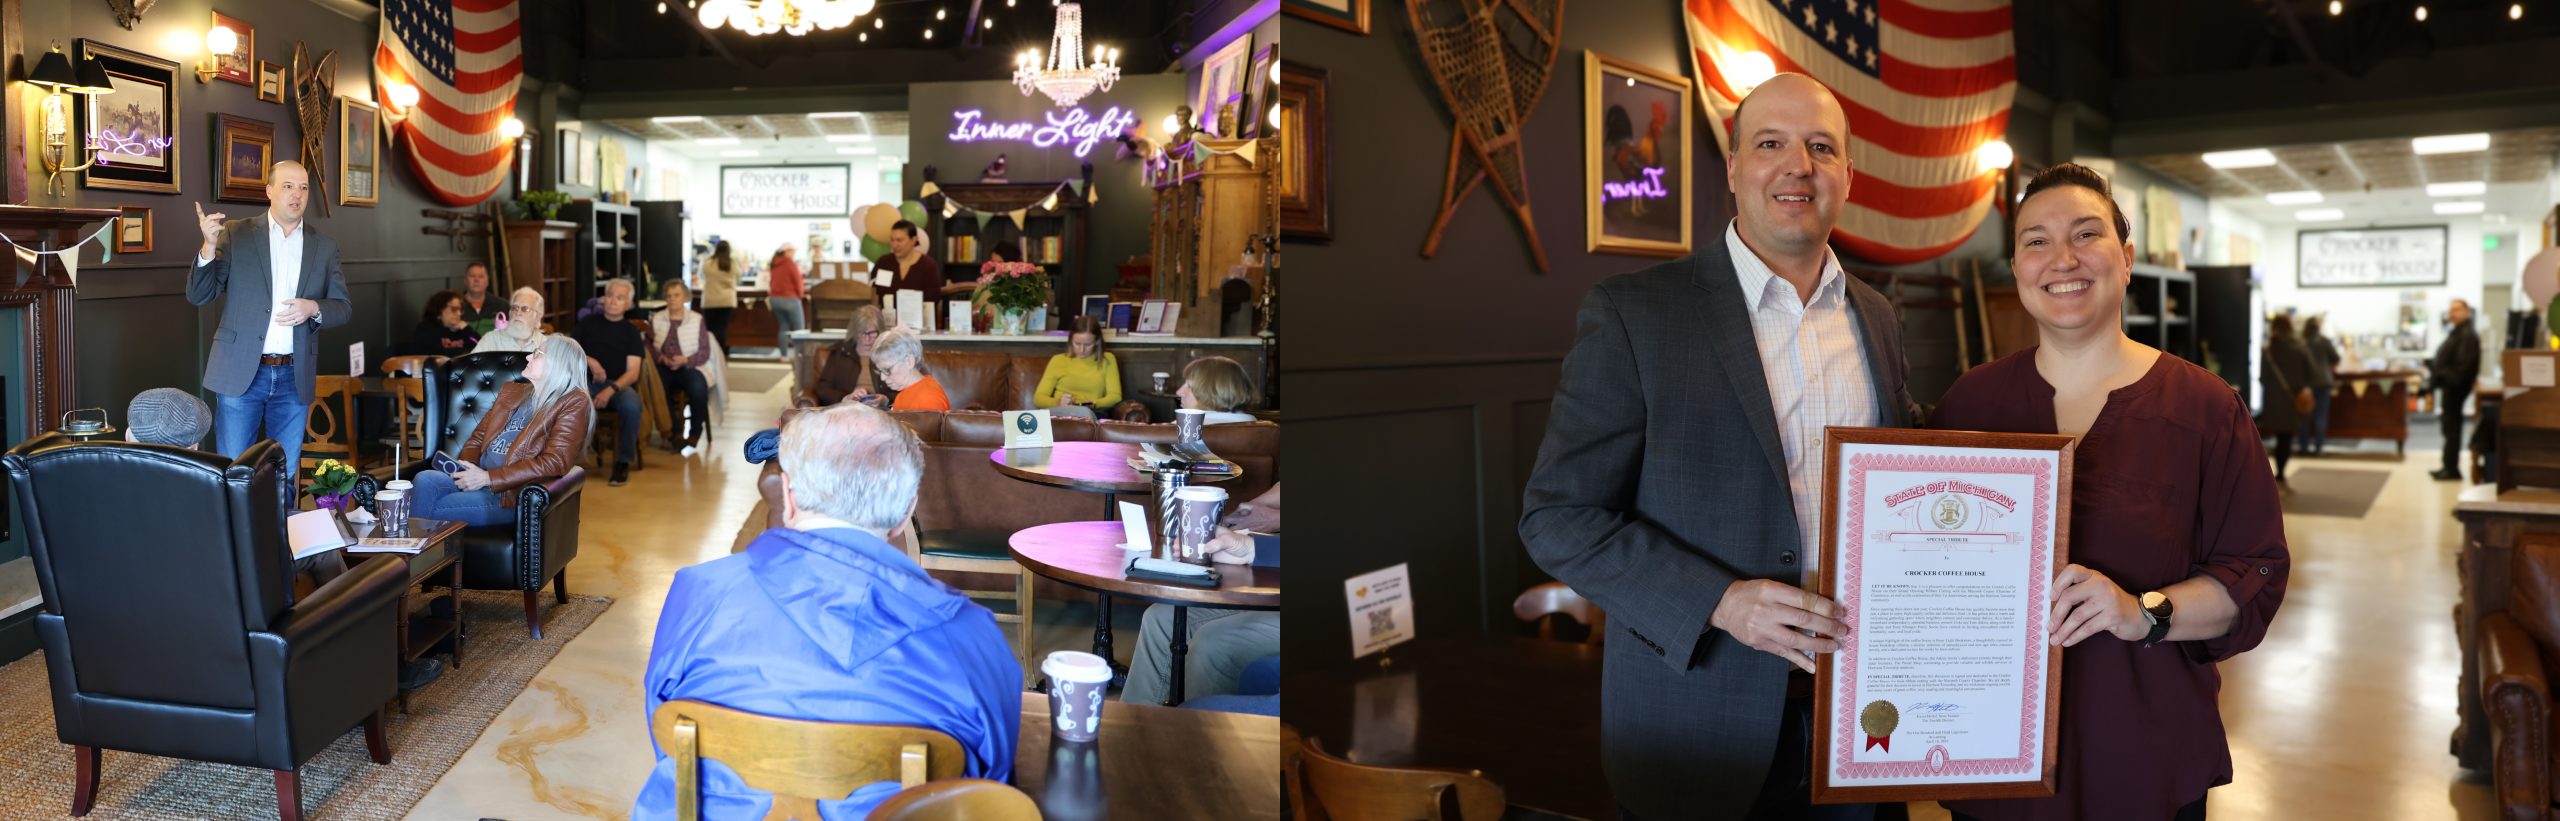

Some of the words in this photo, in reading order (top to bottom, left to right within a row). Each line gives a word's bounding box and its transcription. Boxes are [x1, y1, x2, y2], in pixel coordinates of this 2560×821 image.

[949, 109, 1033, 141] Inner
[1032, 106, 1135, 158] Light
[1885, 485, 1925, 508] STATE
[1926, 481, 1947, 494] OF
[1948, 480, 2016, 512] MICHIGAN
